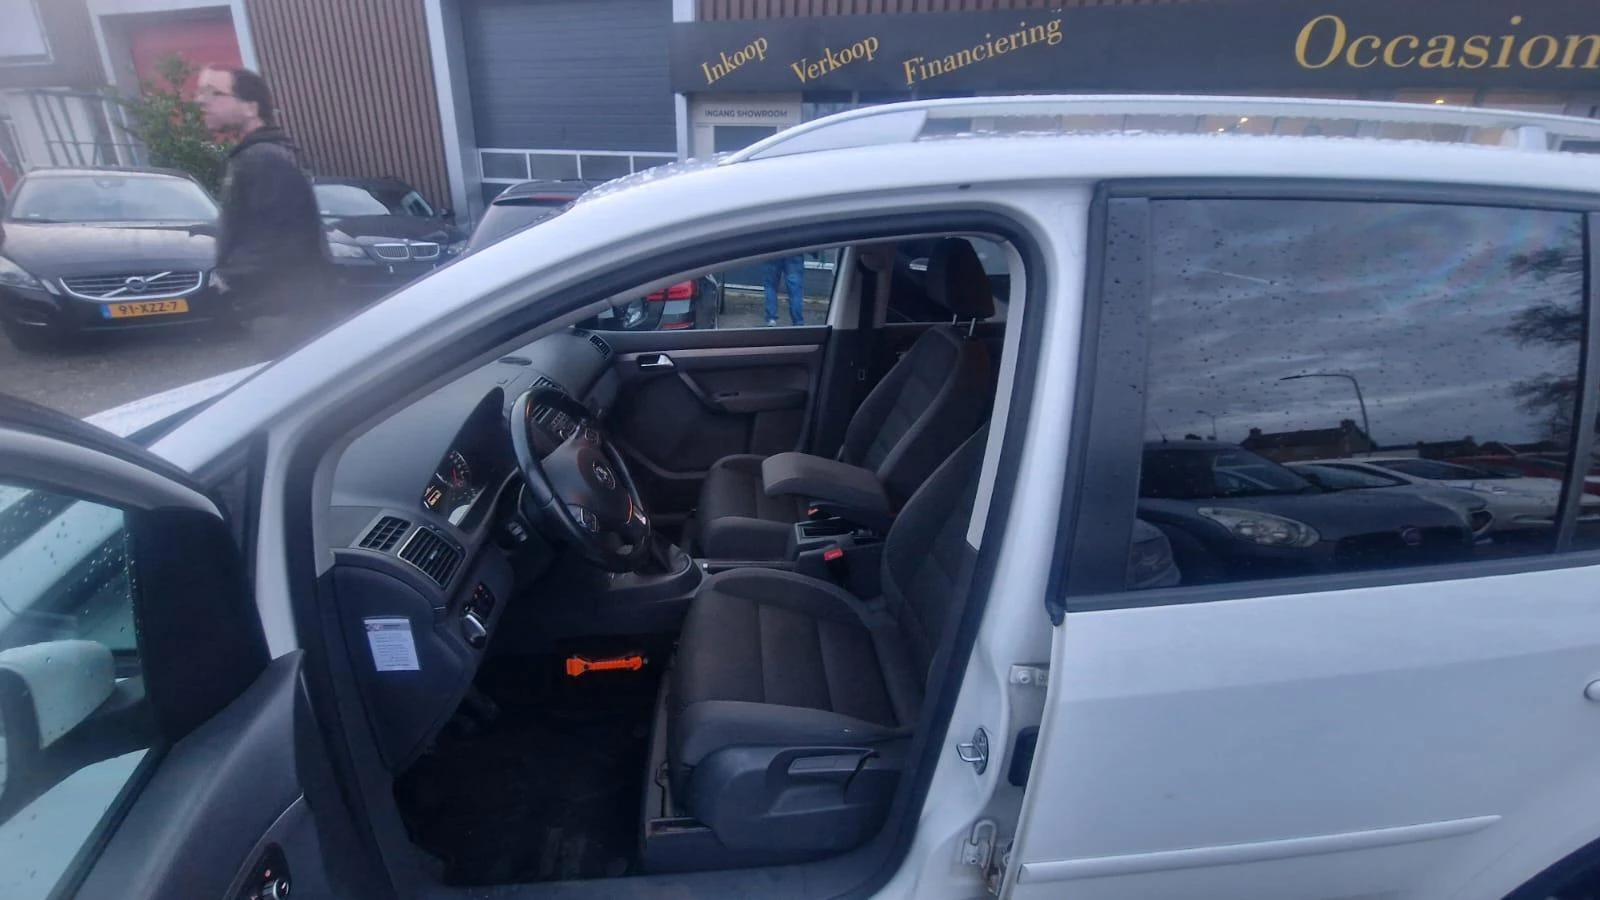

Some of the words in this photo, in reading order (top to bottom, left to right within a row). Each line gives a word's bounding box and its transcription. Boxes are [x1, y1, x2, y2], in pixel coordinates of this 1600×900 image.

[702, 36, 768, 85] Inkoop
[790, 36, 879, 84] Verkoop
[902, 18, 1063, 85] Financiering
[1294, 14, 1600, 69] Occasion
[704, 109, 735, 118] INGANG
[737, 109, 788, 118] SHOWROOM
[118, 301, 177, 315] 91-XZZ-7
